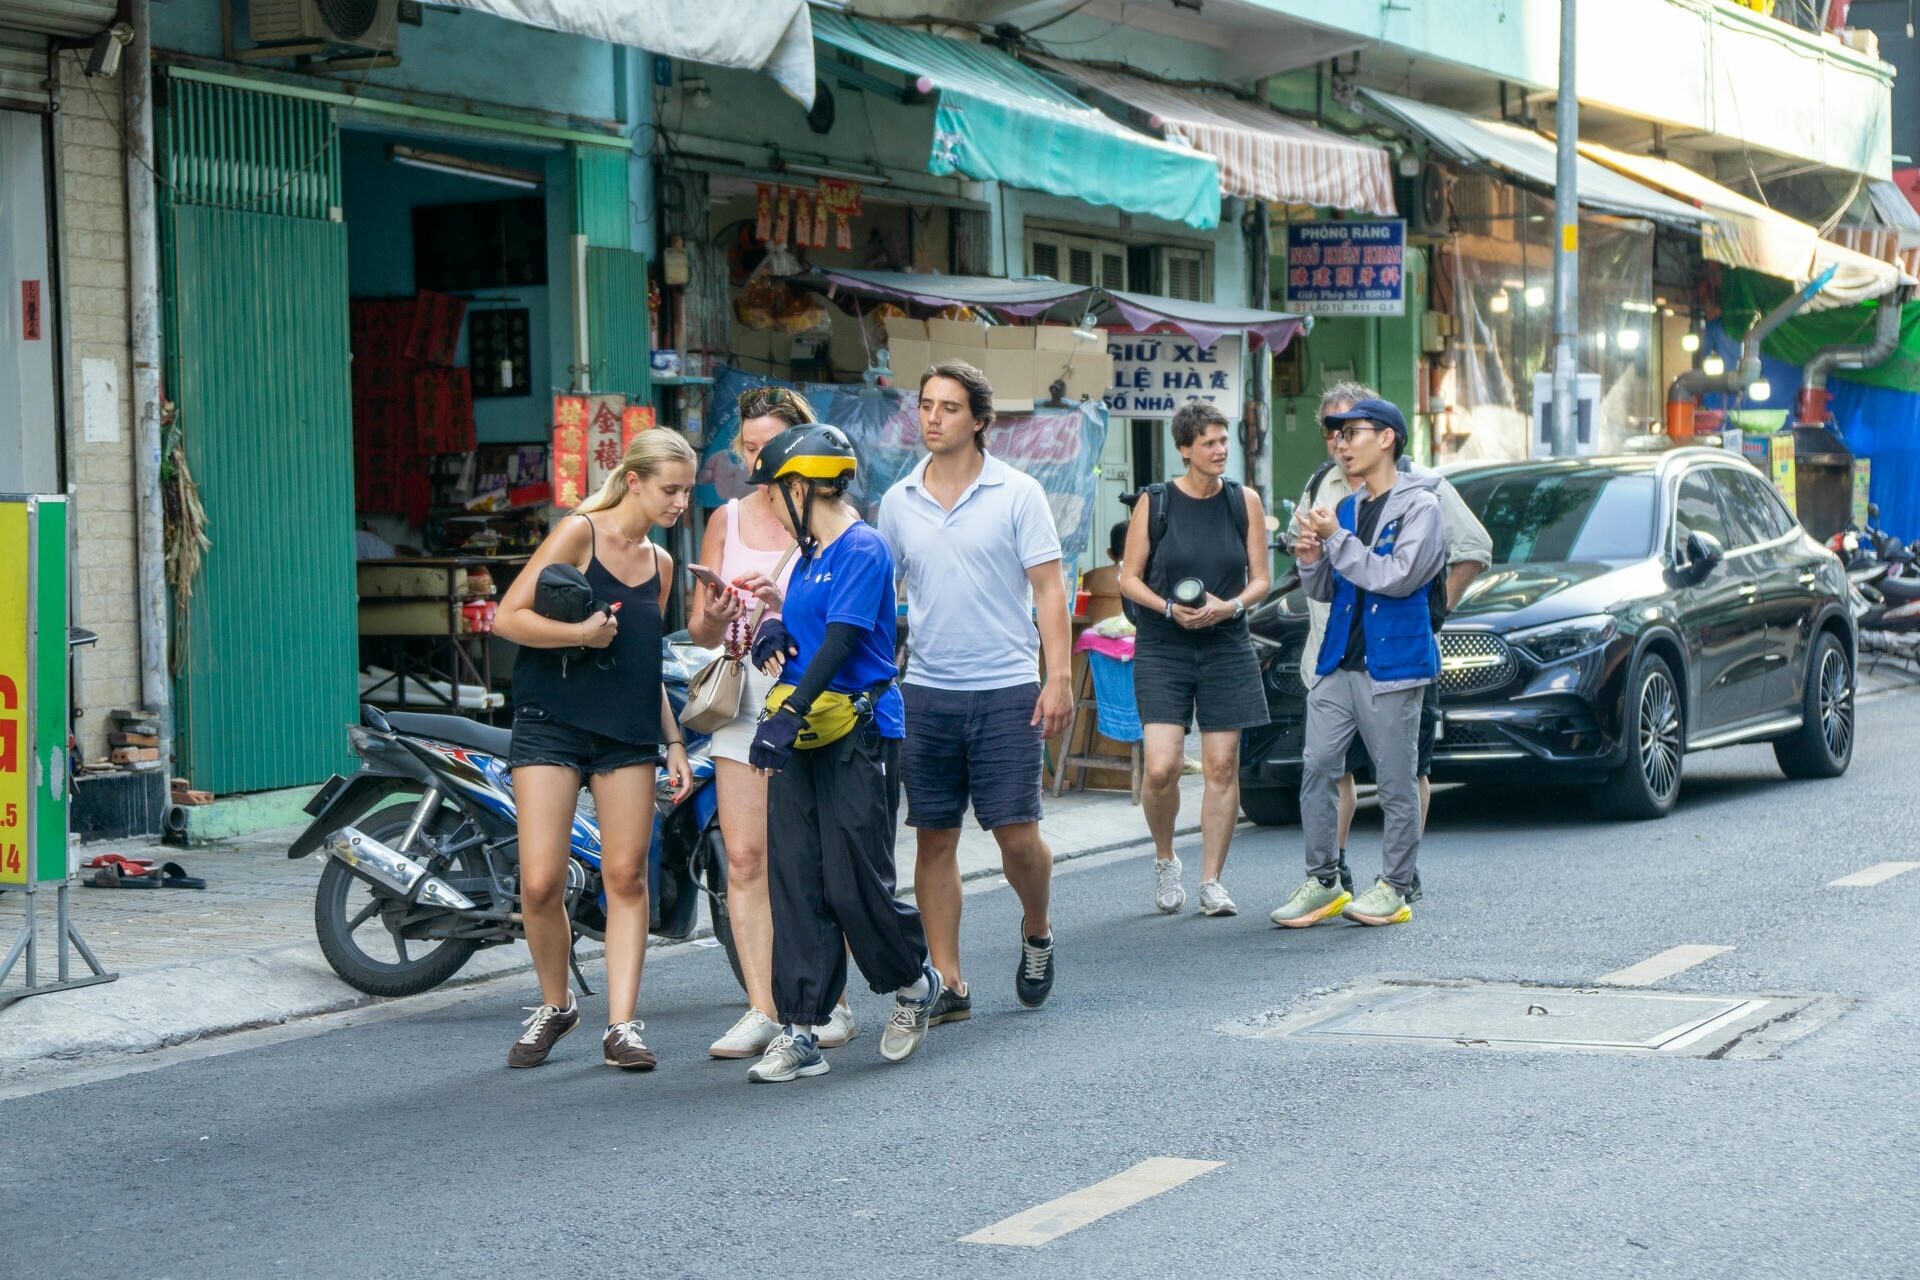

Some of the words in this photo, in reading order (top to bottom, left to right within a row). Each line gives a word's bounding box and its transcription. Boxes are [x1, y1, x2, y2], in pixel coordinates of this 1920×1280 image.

[1301, 225, 1348, 239] PHÒNG
[1352, 225, 1390, 239] RĂNG
[1172, 344, 1217, 363] XE
[1115, 367, 1151, 392] LỆ
[1163, 367, 1203, 389] HÀ
[1102, 390, 1127, 410] SỐ
[1134, 392, 1175, 410] NHÀ
[589, 401, 622, 491] 金禧
